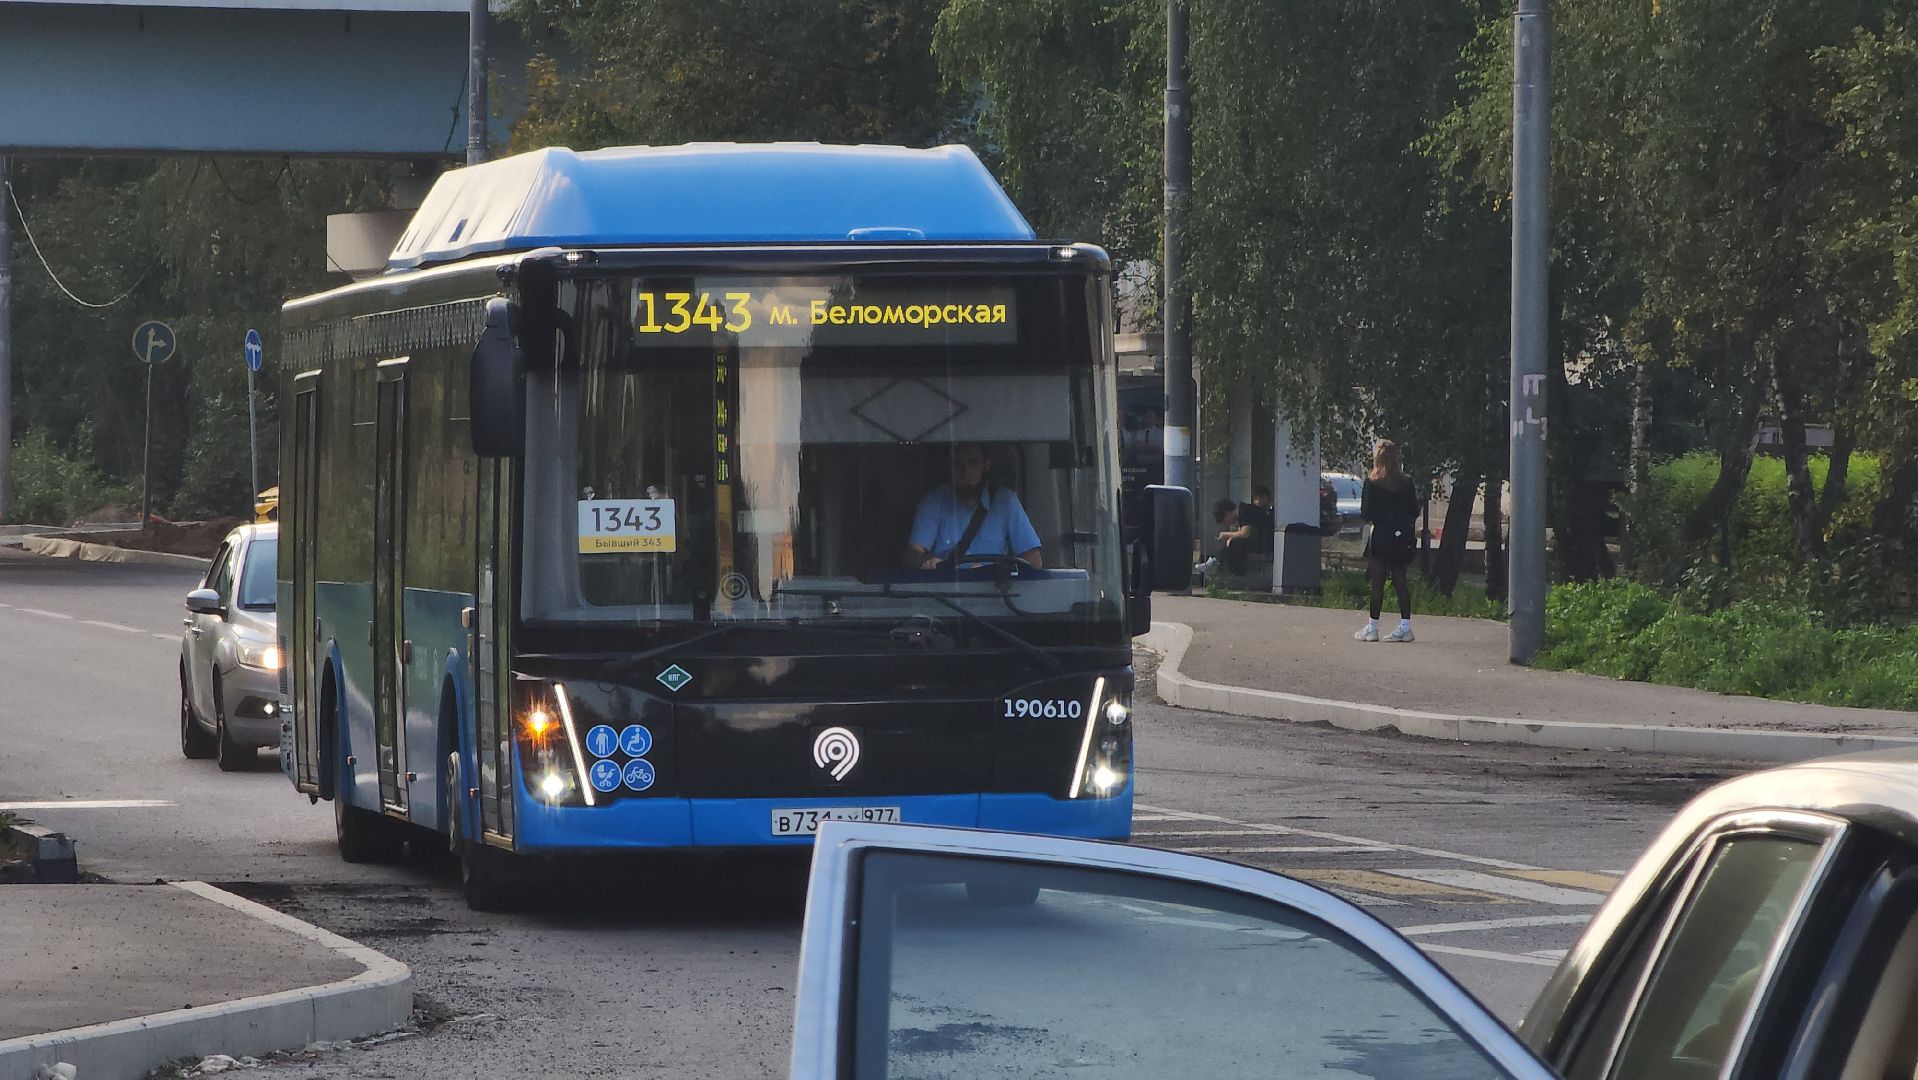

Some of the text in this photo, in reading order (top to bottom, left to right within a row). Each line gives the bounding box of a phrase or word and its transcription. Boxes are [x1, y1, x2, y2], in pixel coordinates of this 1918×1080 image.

[639, 292, 1006, 333] 1343 м. Беломорская
[591, 506, 661, 531] 1343
[595, 538, 662, 548] Бывший 343
[1004, 698, 1081, 718] 190610
